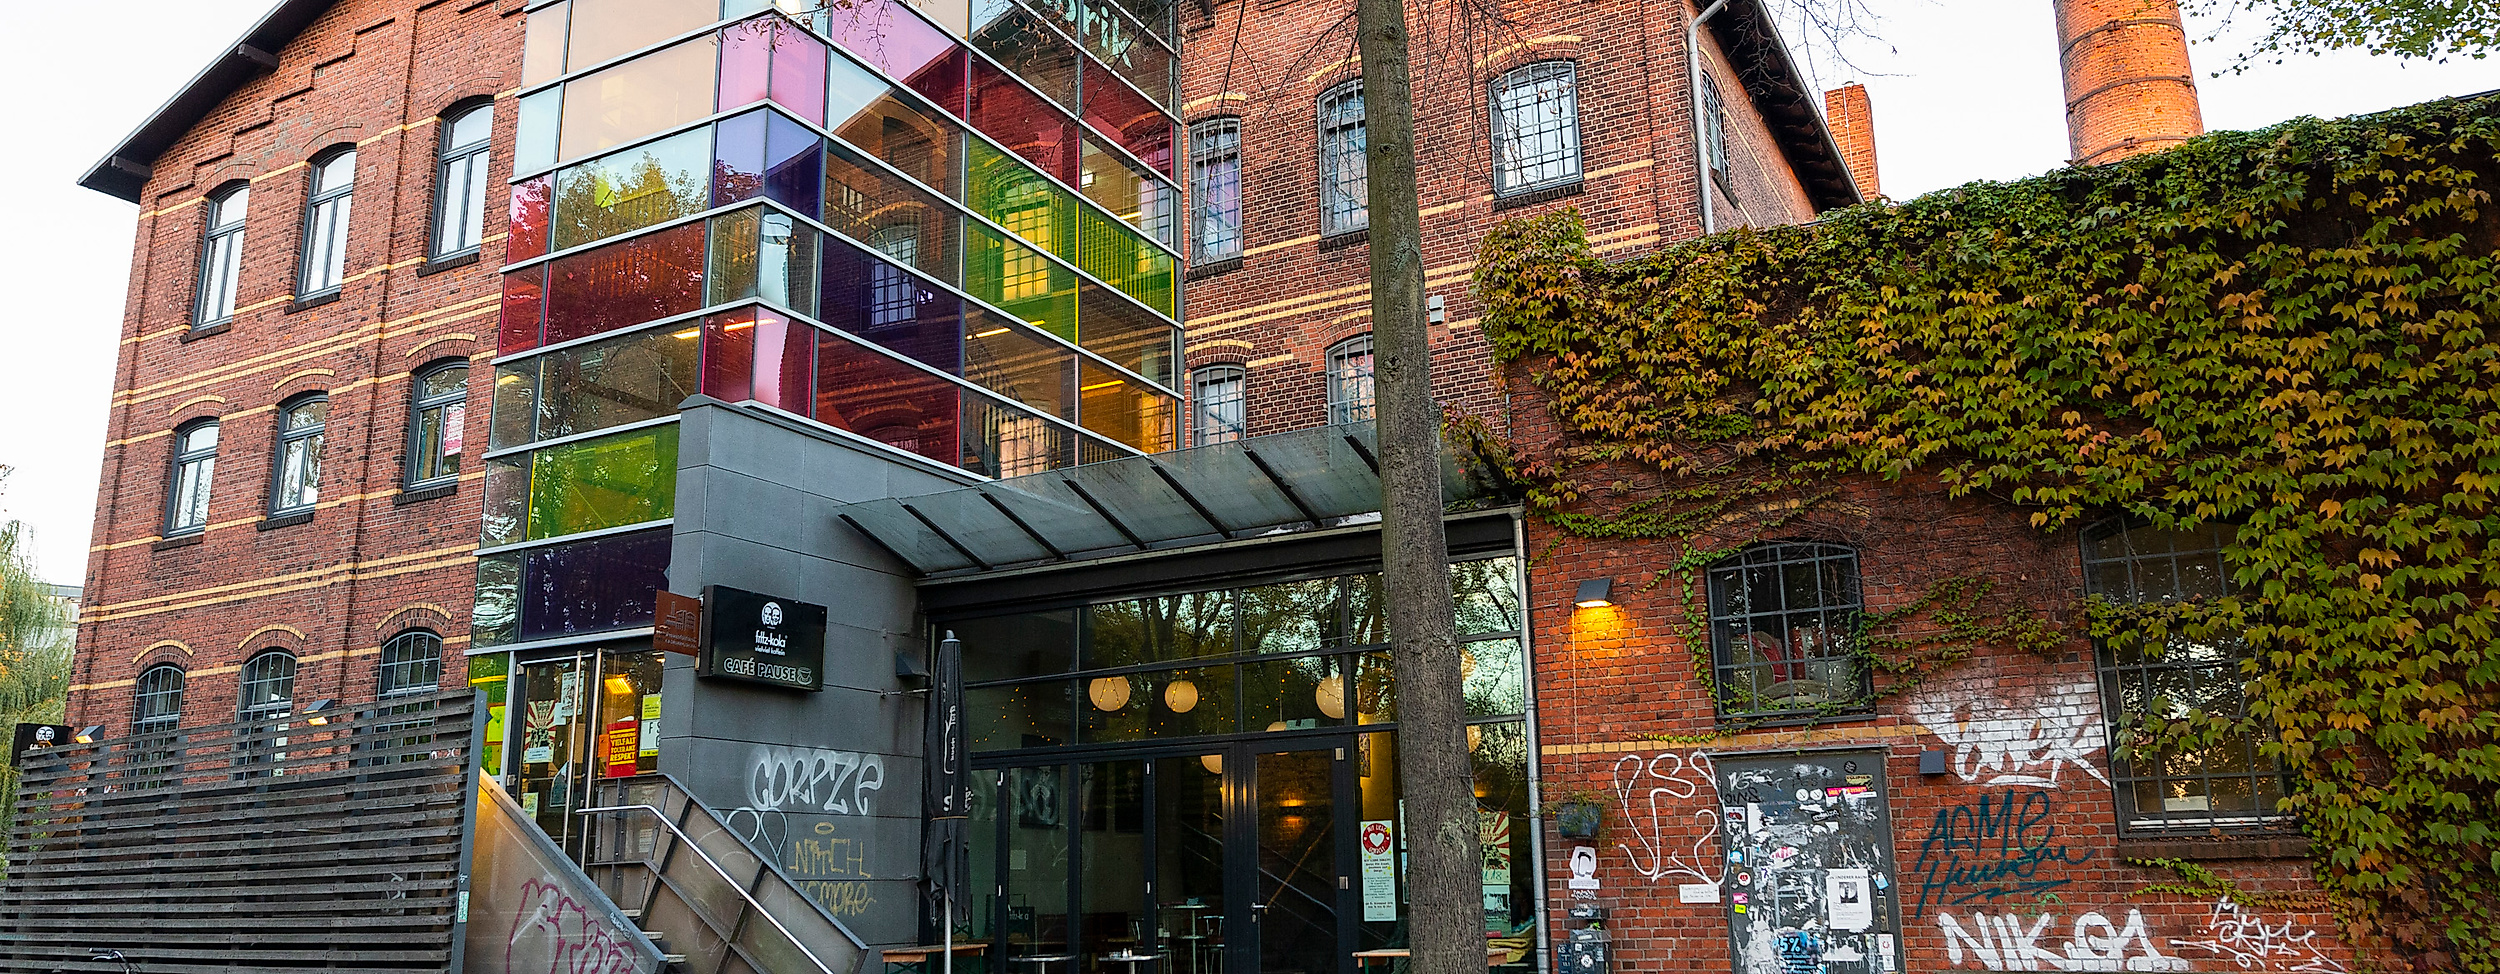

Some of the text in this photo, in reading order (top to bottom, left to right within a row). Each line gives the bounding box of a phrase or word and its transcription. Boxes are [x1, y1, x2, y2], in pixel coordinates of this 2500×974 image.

[723, 657, 797, 682] CAFÉ PAUSE
[610, 736, 636, 747] VIELFALT
[609, 752, 635, 761] RESPEKT
